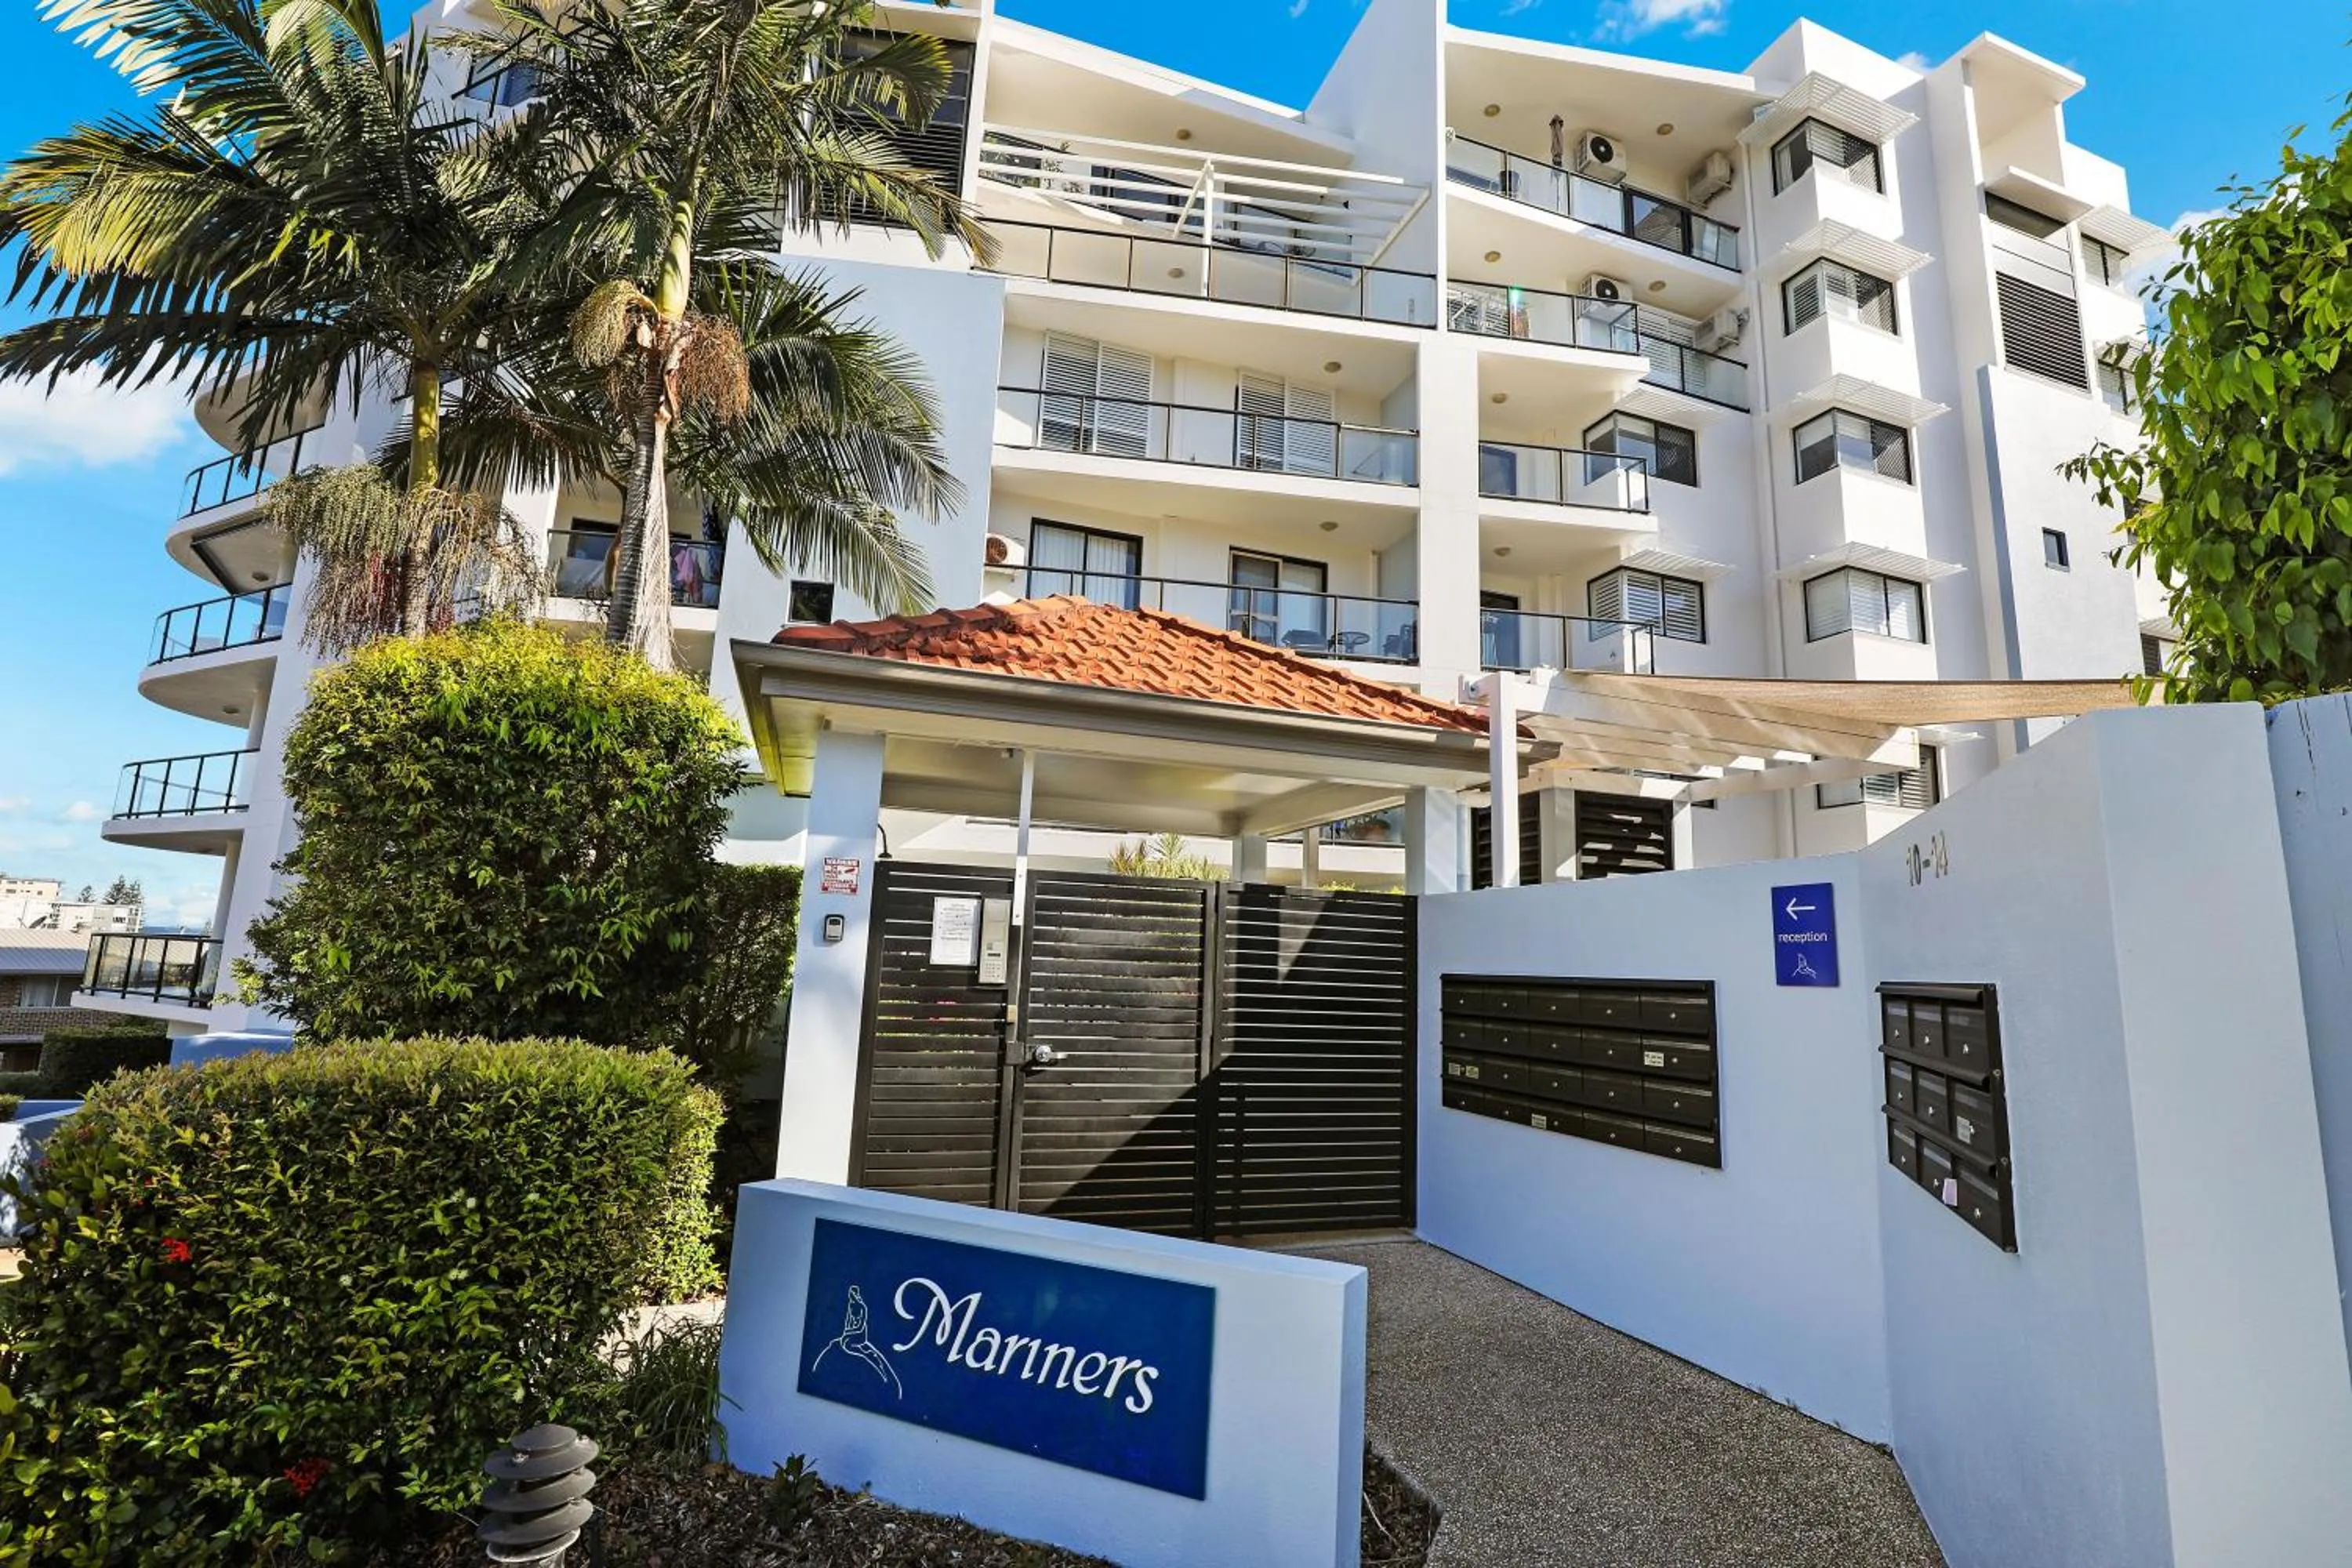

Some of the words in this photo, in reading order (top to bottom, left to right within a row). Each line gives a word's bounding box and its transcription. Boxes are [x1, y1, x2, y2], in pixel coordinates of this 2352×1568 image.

[1906, 829, 1948, 887] 10-14
[1777, 931, 1828, 944] reception
[892, 1277, 1160, 1414] Mariners
